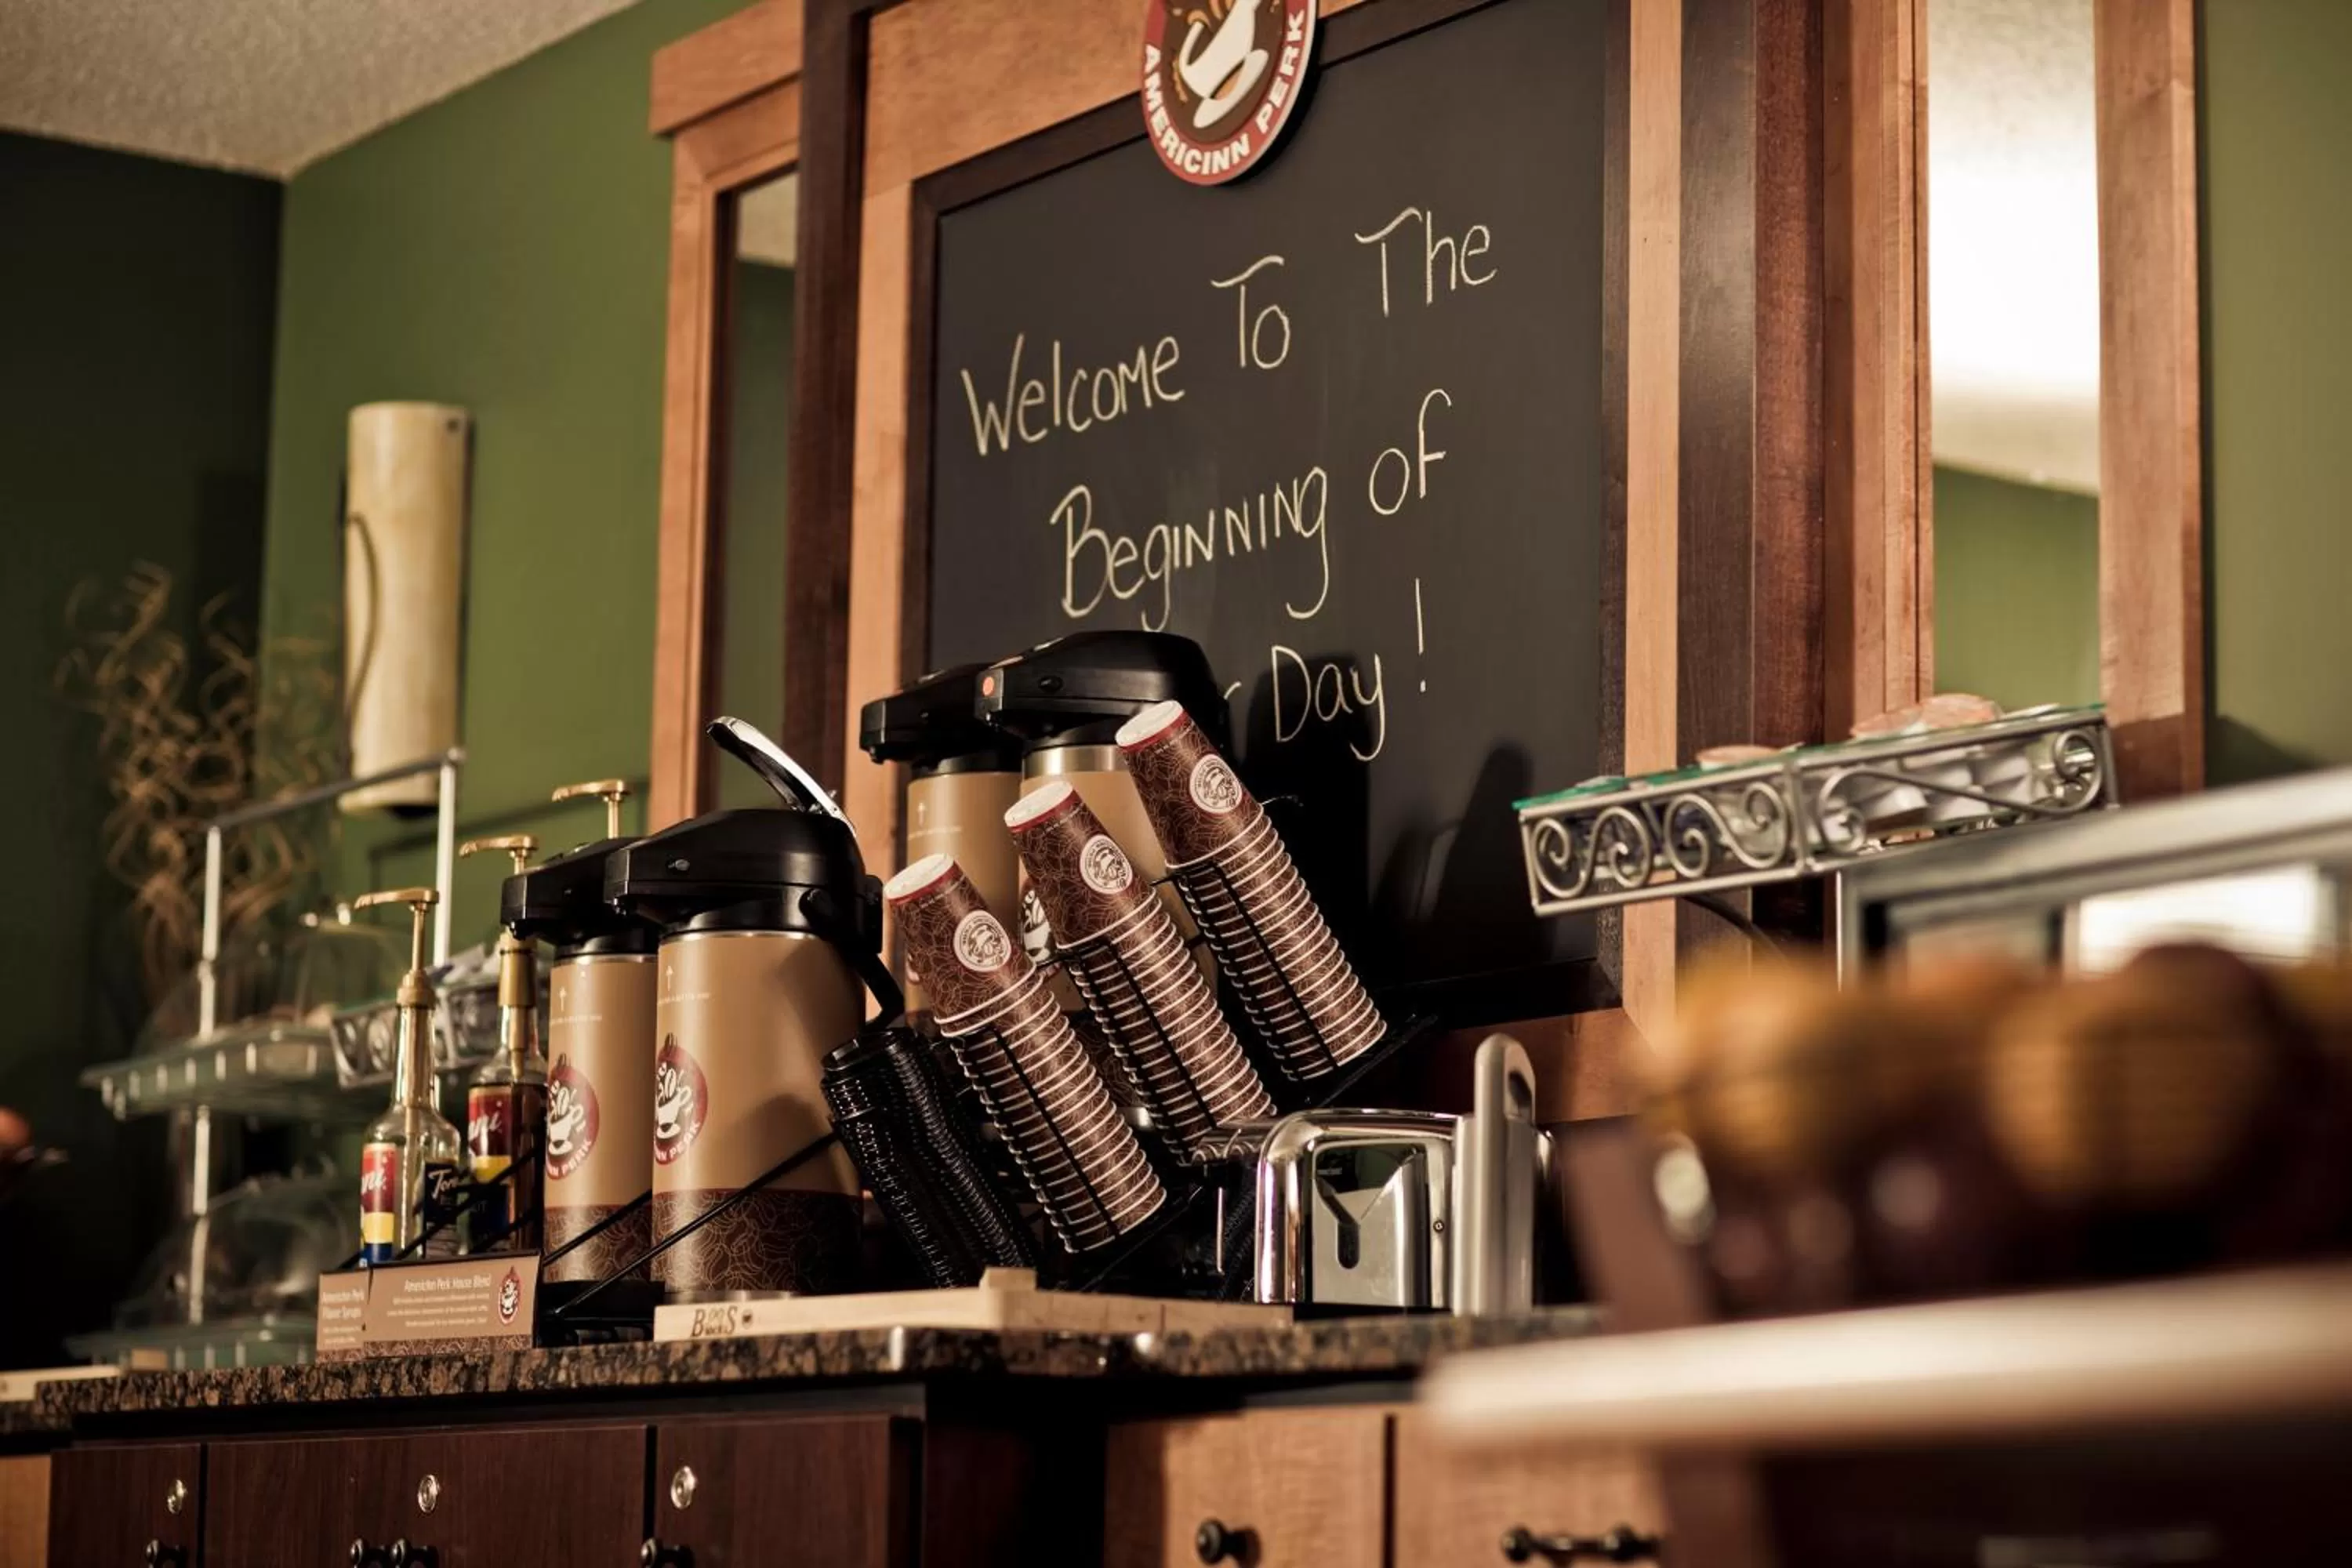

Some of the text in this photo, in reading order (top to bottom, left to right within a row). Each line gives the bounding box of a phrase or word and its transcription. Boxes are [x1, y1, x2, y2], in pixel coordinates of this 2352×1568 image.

[1145, 9, 1305, 175] AMERICINN PERK
[1210, 255, 1290, 369] To
[1354, 207, 1497, 316] The
[1369, 388, 1452, 515] of
